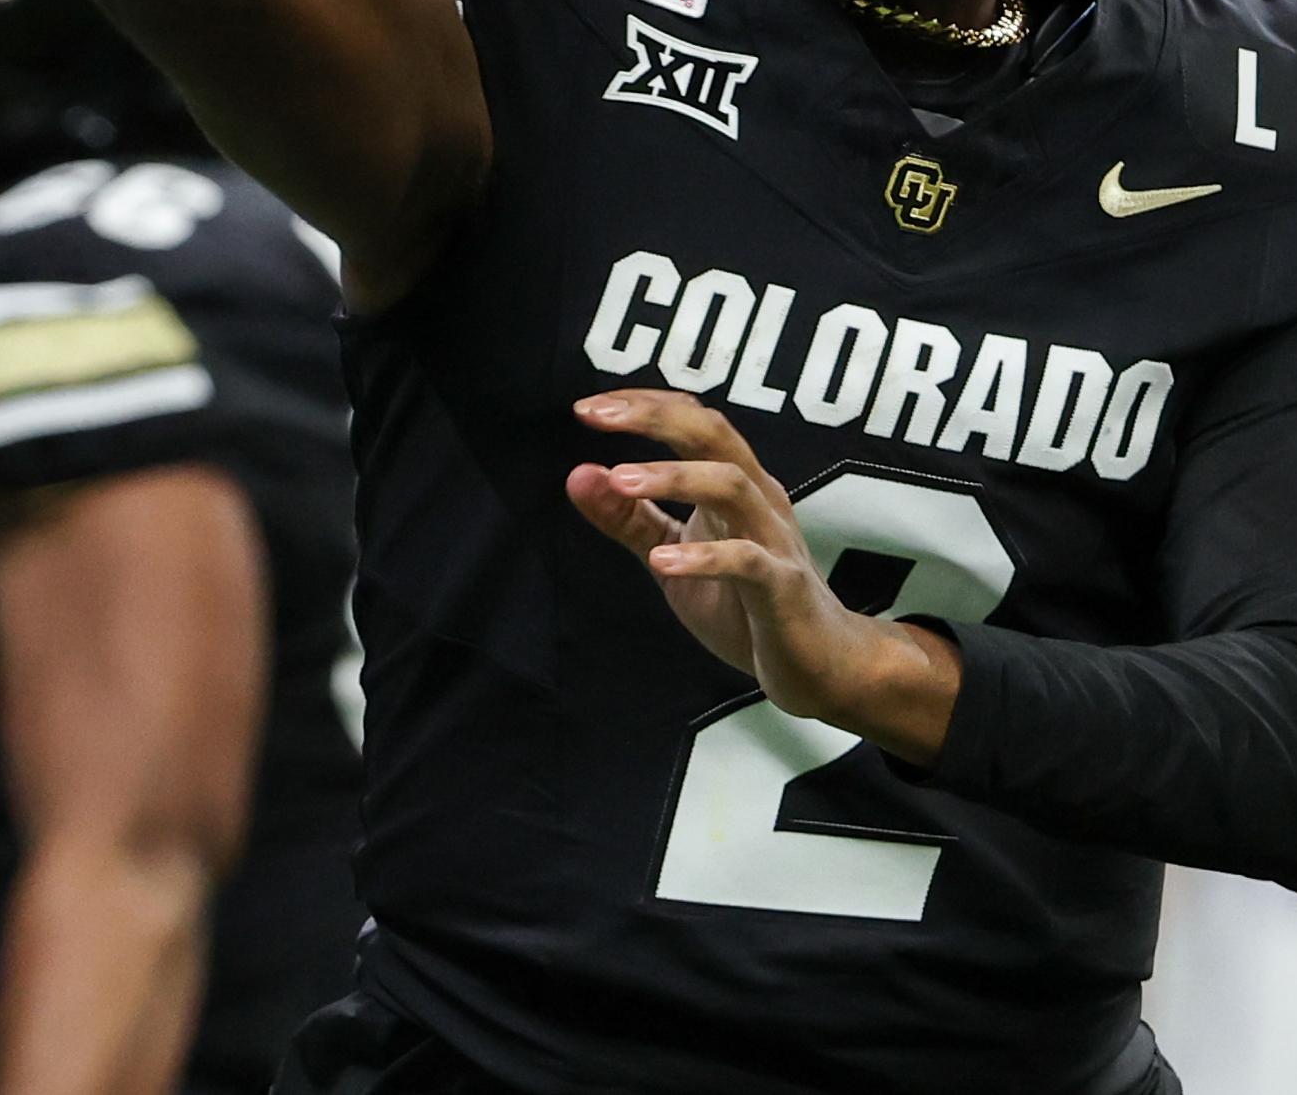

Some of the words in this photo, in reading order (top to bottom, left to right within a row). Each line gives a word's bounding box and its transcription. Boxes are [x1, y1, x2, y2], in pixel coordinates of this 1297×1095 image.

[1235, 47, 1278, 151] L
[583, 251, 1174, 481] COLORADO
[655, 473, 1016, 923] 2
